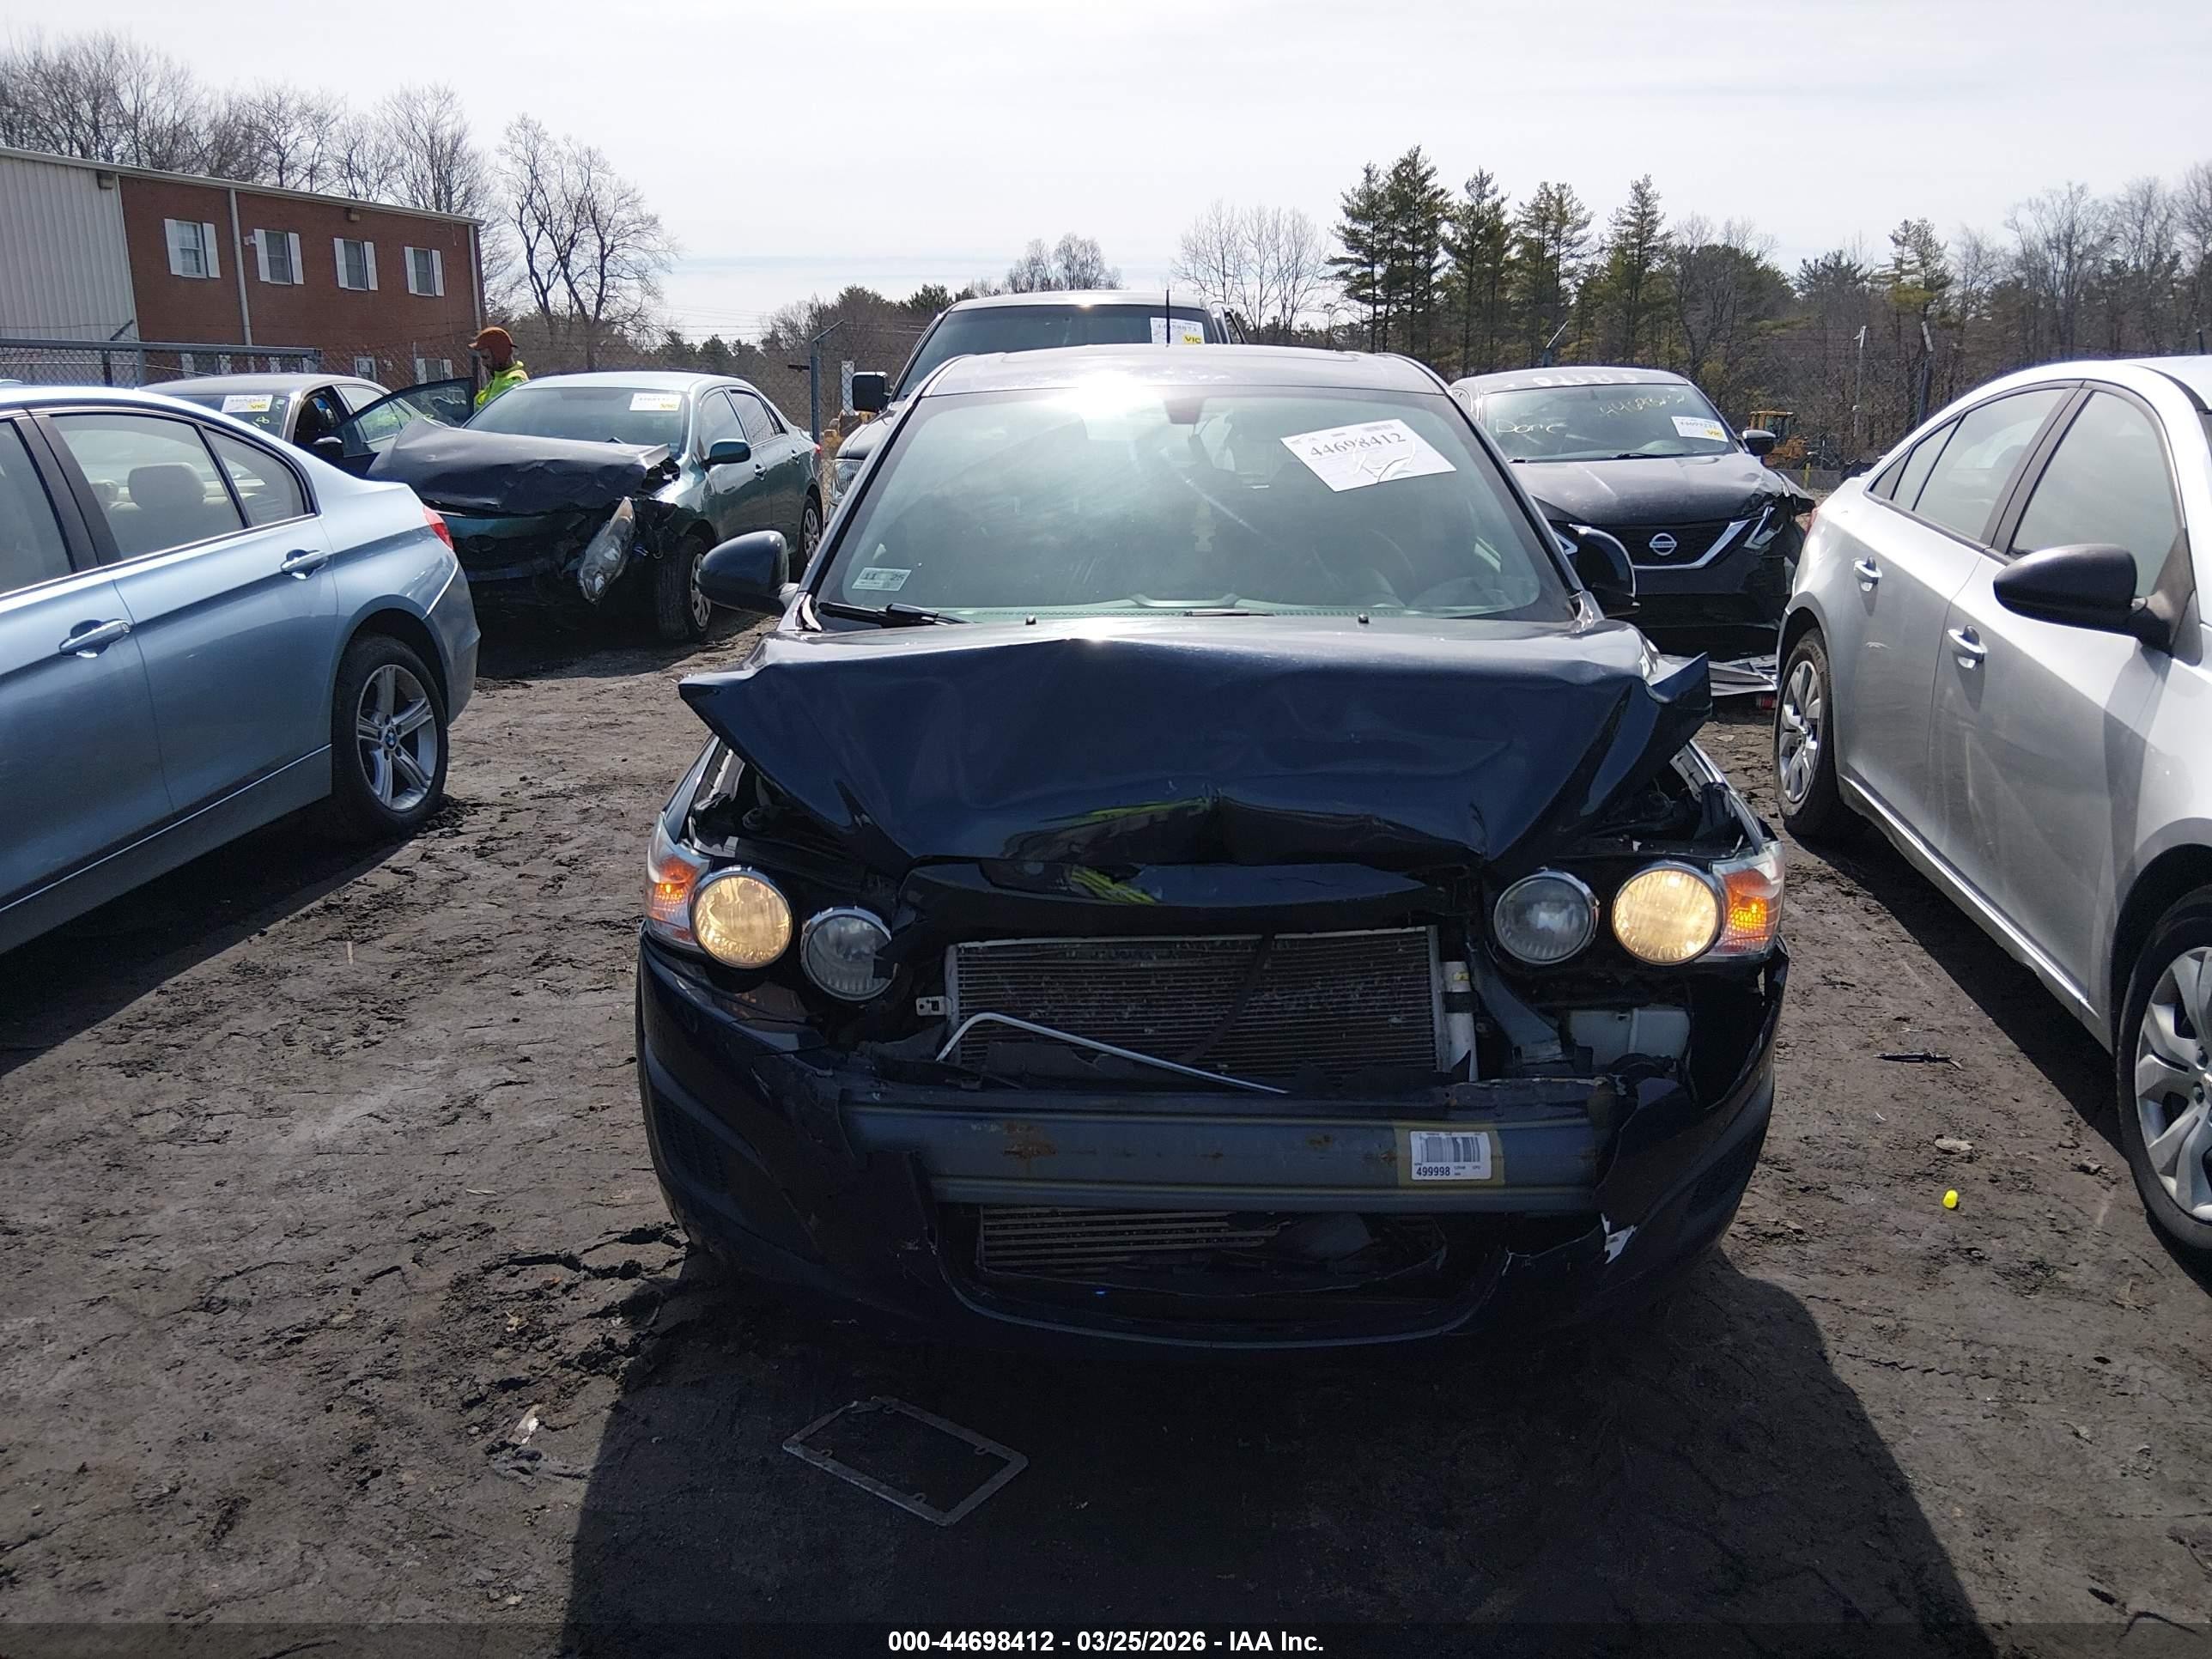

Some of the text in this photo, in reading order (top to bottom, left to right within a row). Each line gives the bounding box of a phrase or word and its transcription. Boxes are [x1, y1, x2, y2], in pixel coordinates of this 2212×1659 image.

[1184, 336, 1201, 344] VIC
[1310, 432, 1407, 457] 44698412
[1416, 1166, 1450, 1177] 499998
